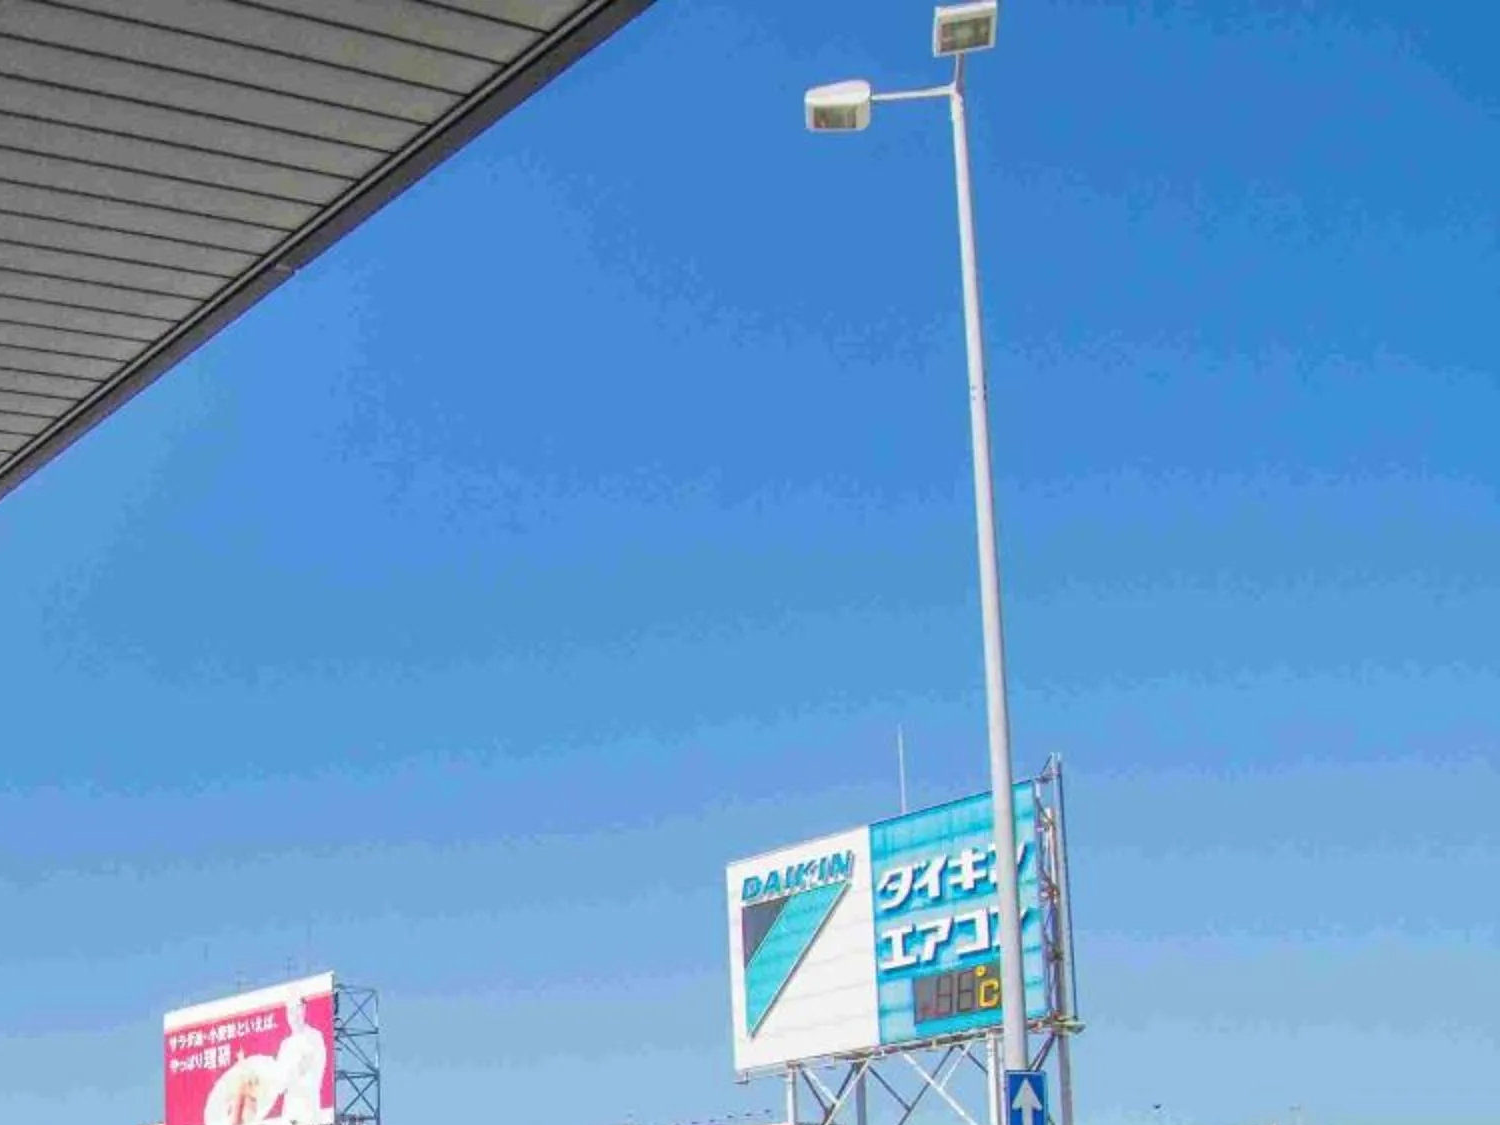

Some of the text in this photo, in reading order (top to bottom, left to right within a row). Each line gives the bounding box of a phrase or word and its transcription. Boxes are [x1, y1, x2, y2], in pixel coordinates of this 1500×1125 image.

[741, 849, 854, 901] DAIKIN
[880, 907, 1037, 971] エアコ
